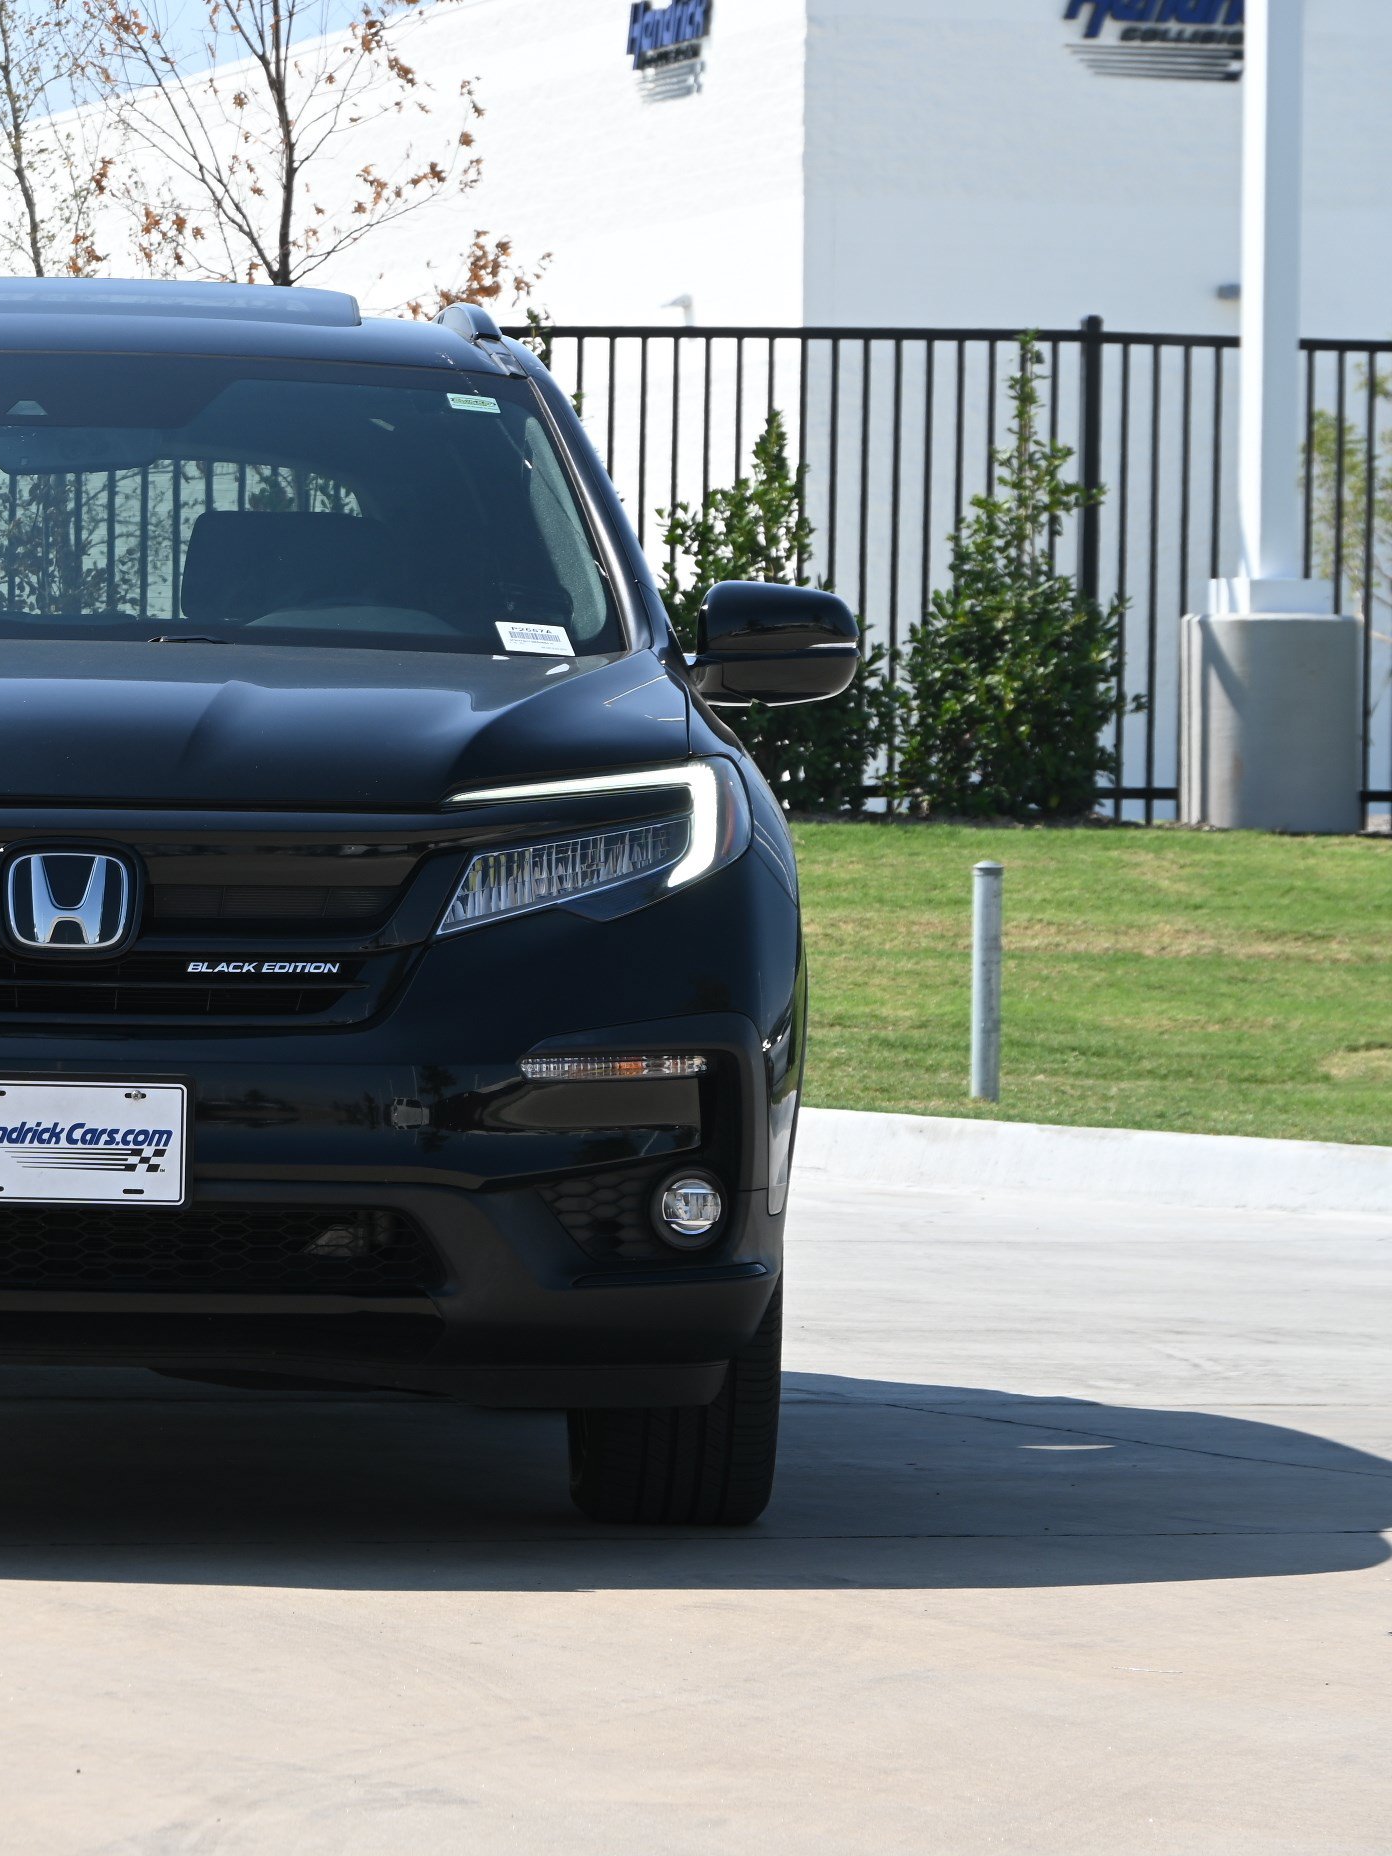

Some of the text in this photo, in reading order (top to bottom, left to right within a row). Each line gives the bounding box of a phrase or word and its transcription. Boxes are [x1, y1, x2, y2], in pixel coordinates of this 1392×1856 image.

[1120, 26, 1244, 45] COLLISIO
[187, 961, 340, 974] BLACK EDITION
